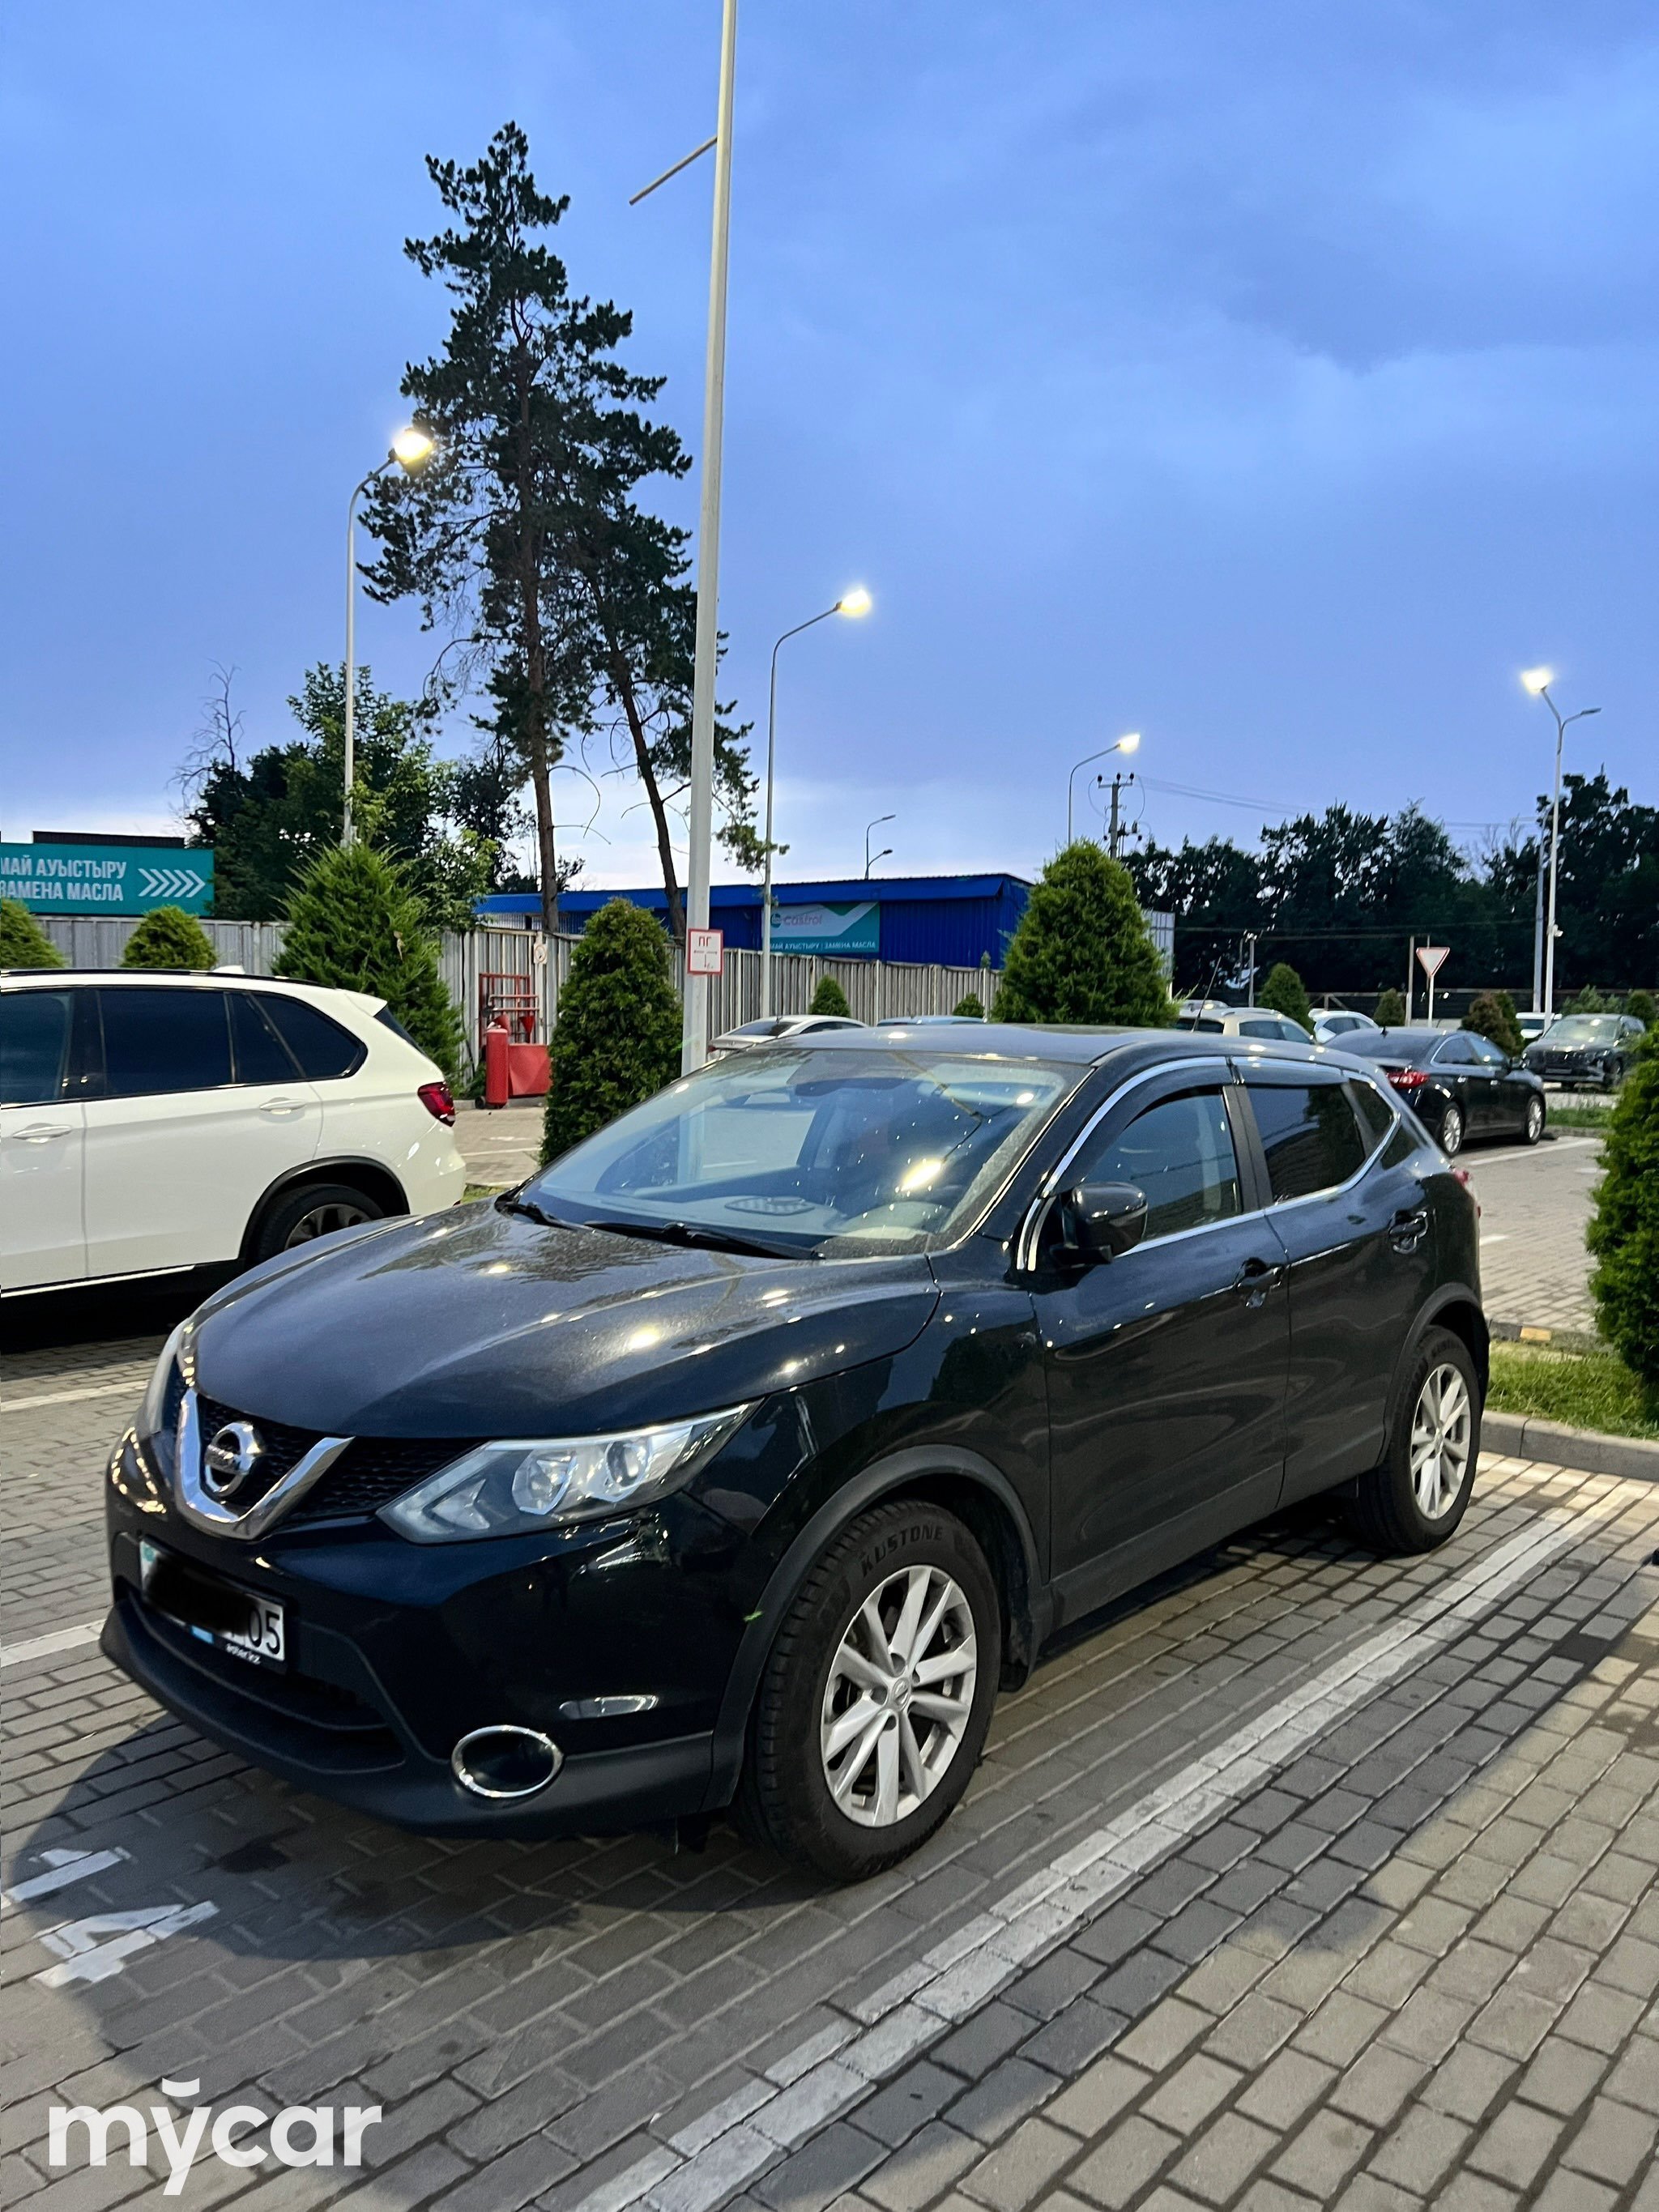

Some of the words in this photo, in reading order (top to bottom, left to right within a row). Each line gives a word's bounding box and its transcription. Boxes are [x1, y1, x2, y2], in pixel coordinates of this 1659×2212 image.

[36, 859, 127, 880] АУЫСТЫРУ
[67, 882, 124, 901] МАСЛА
[860, 1525, 944, 1578] KUSTONE
